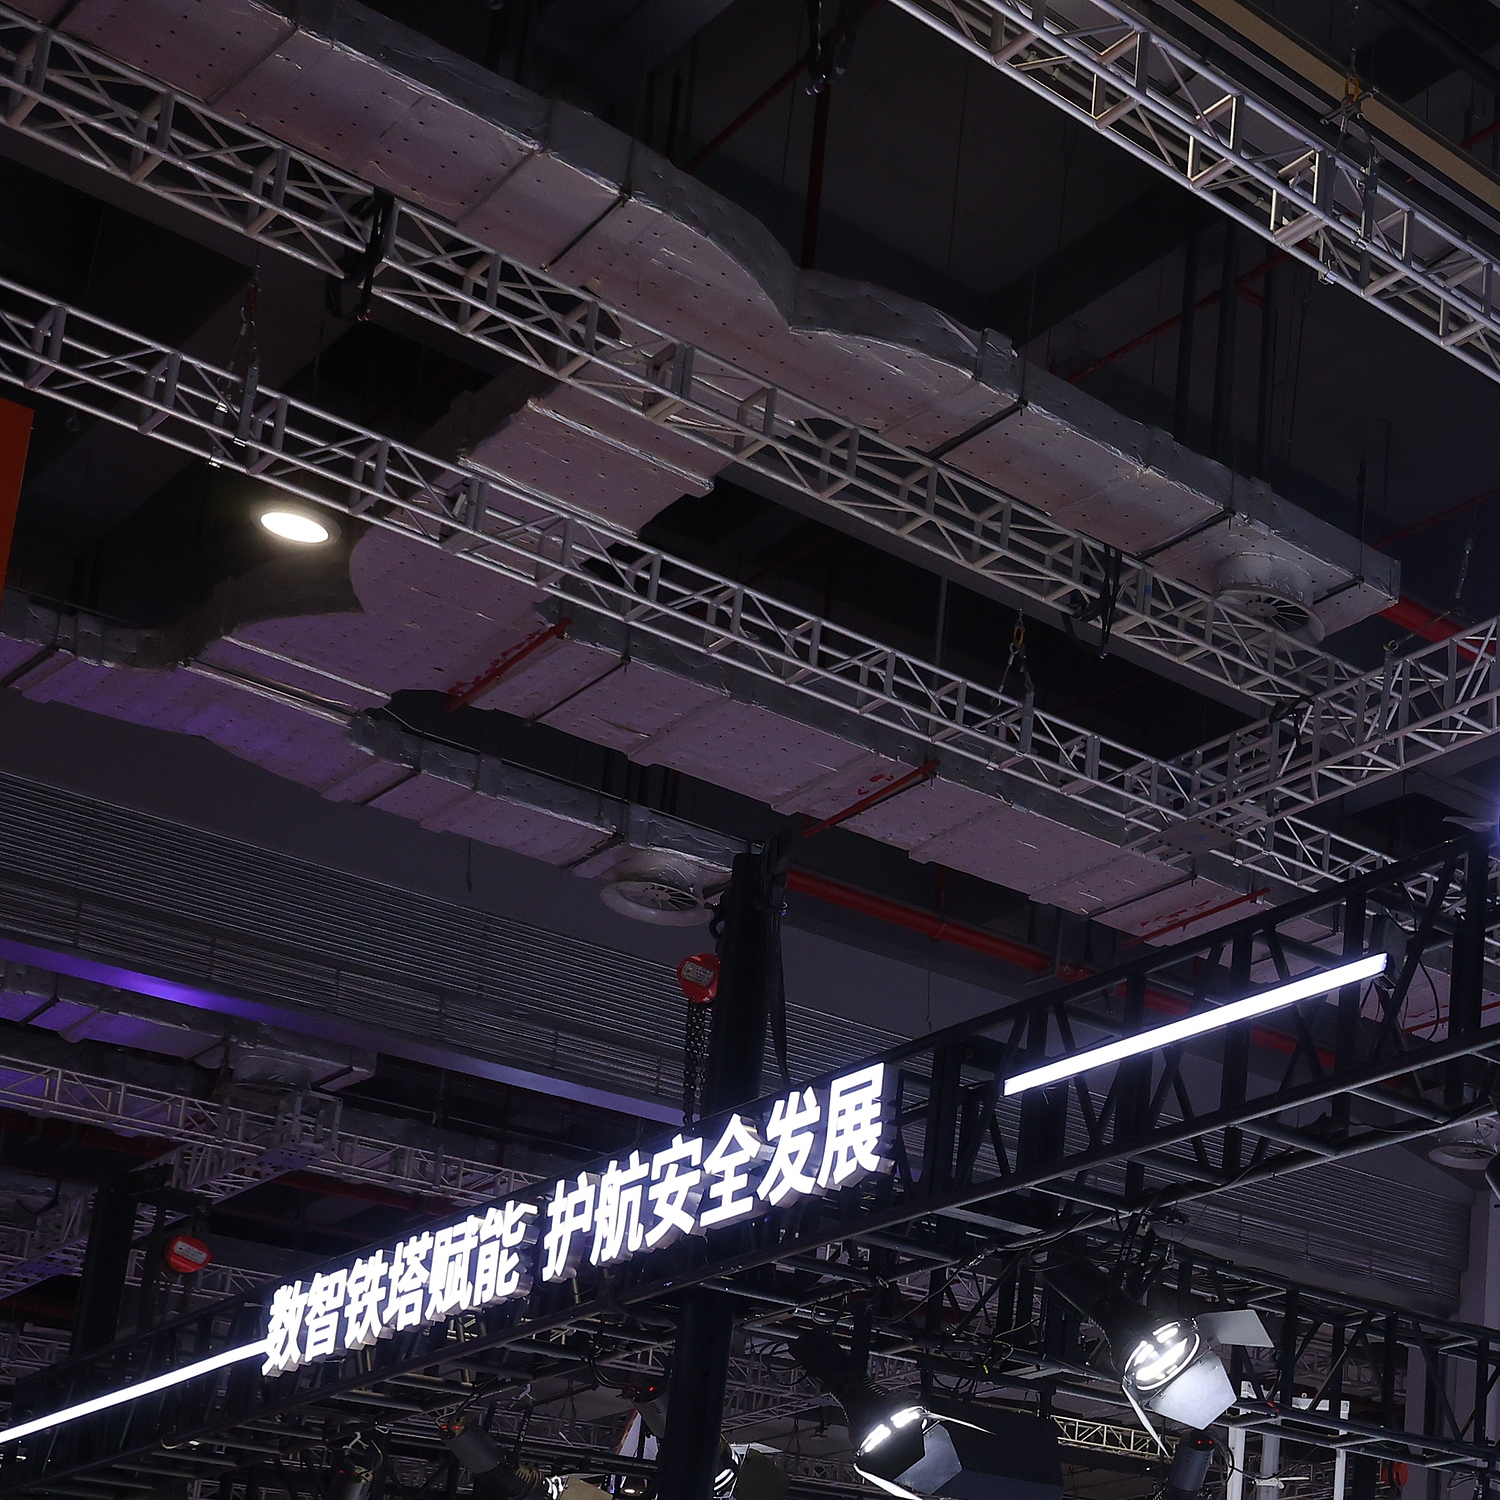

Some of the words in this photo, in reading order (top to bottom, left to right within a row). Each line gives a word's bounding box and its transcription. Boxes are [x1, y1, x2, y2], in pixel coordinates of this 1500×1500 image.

[262, 1200, 538, 1376] 数智铁塔赋能
[541, 1062, 888, 1282] 护航安全发展
